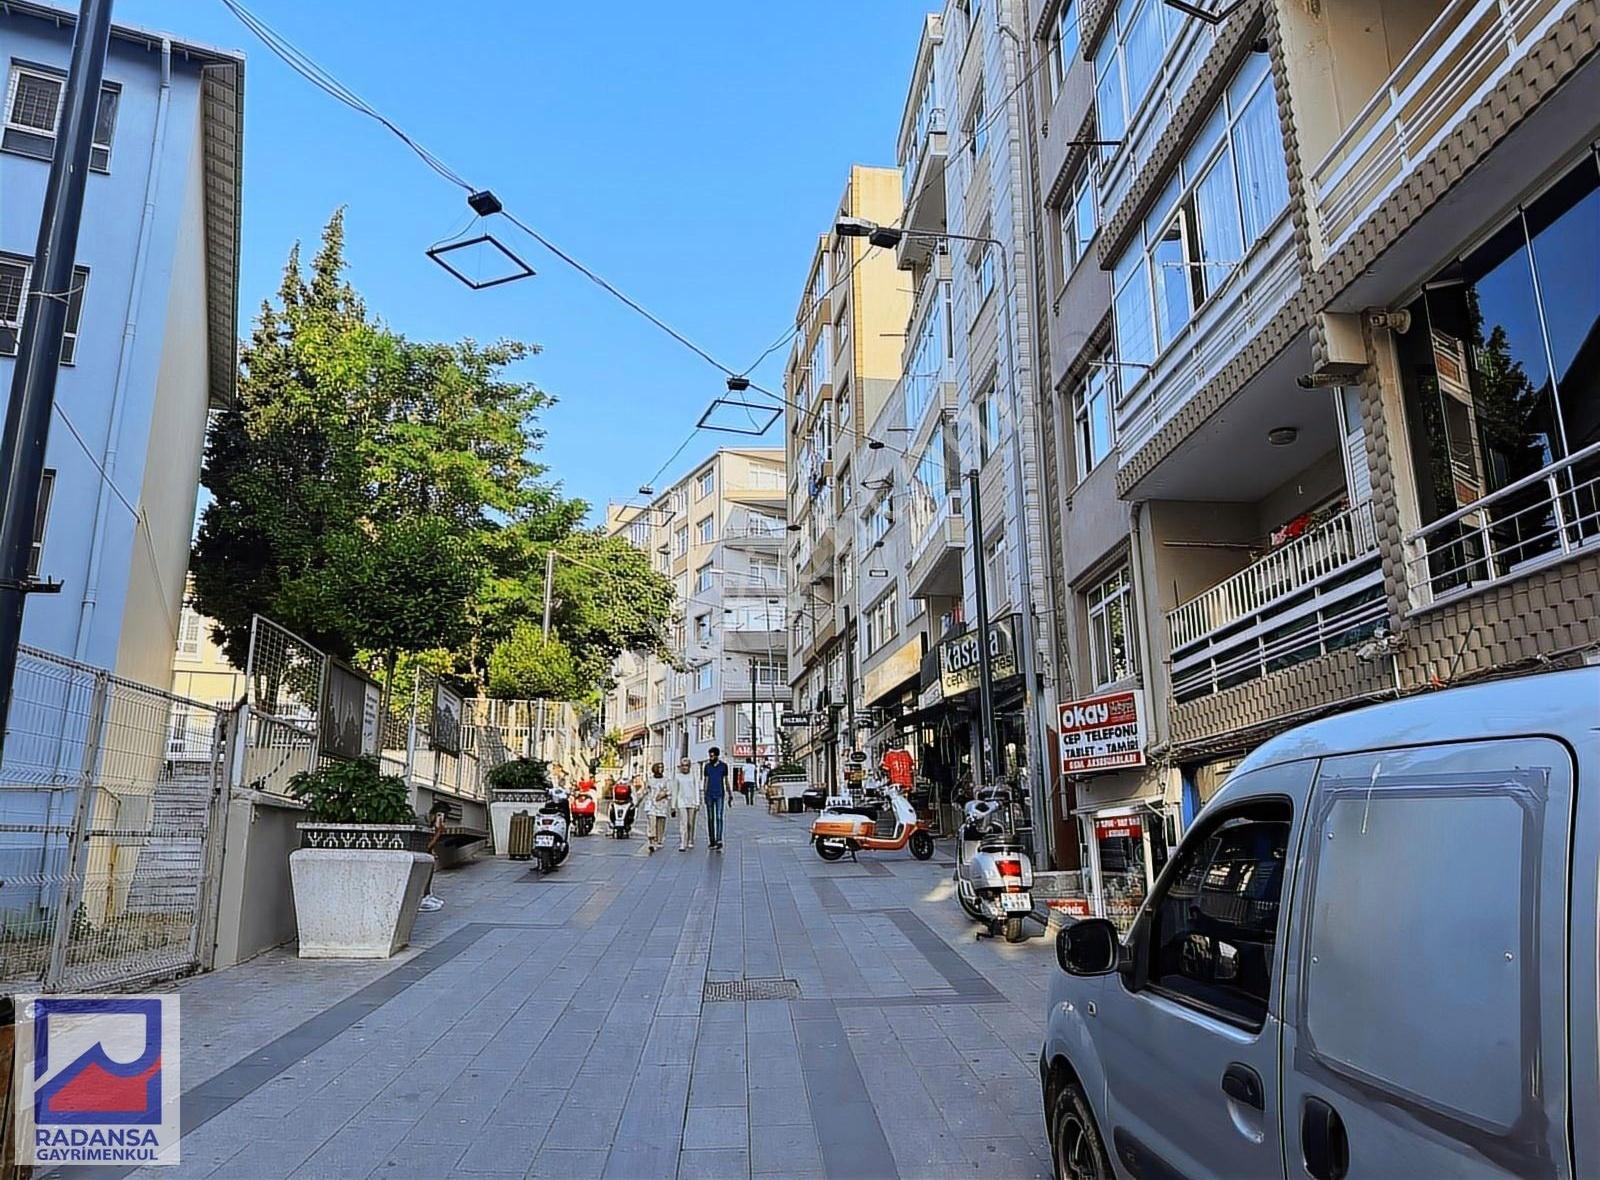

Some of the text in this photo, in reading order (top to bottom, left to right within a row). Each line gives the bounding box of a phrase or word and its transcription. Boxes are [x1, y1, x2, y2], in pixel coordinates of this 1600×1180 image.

[943, 630, 999, 673] kasaa
[1063, 723, 1138, 745] CEP TELEFONU
[1065, 745, 1095, 759] TABLET
[1106, 736, 1139, 754] TAMİRİ
